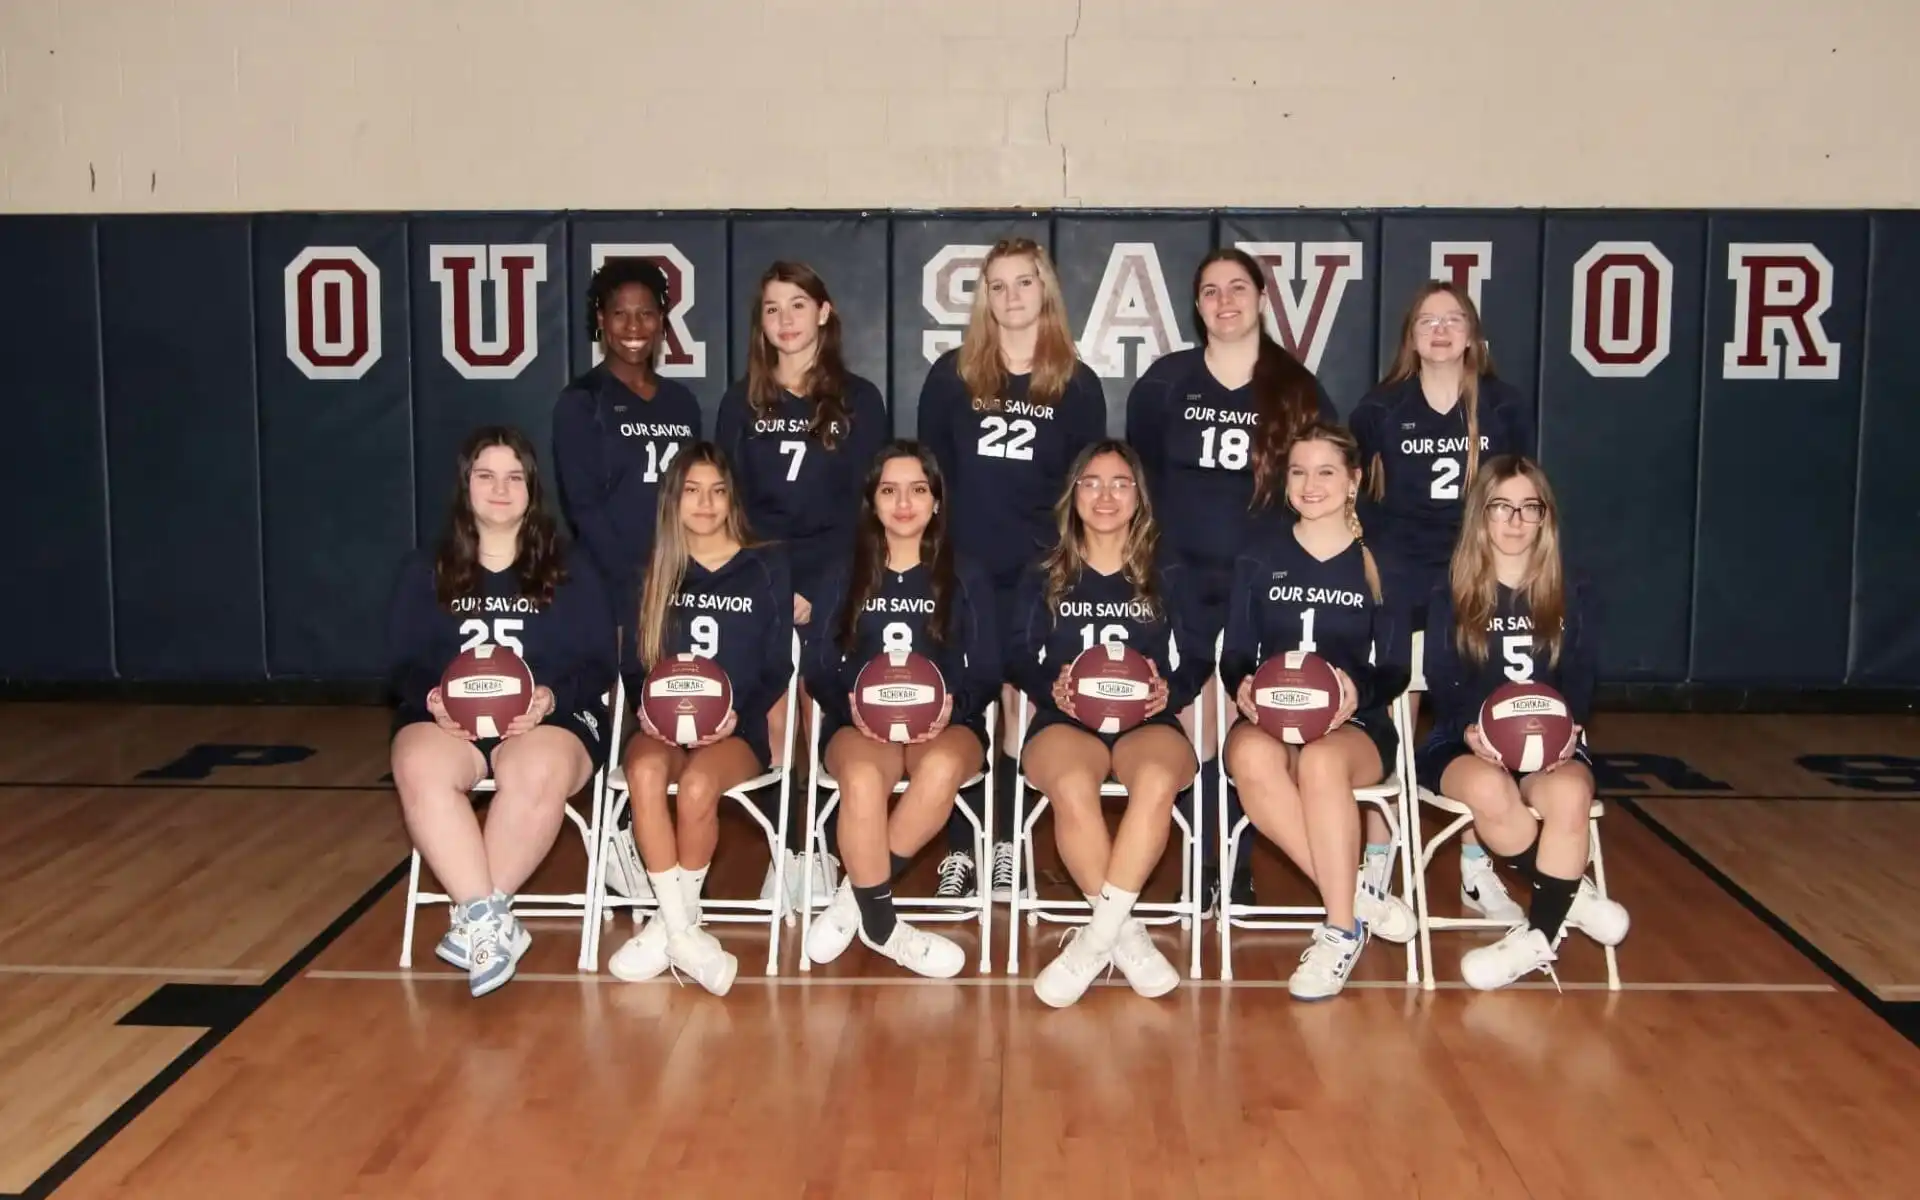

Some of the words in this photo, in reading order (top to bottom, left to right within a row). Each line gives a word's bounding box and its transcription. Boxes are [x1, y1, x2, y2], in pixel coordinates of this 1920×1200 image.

[1004, 399, 1054, 420] SAVIOR
[1184, 406, 1216, 421] OUR
[1218, 410, 1259, 426] SAVIO
[620, 422, 650, 437] OUR
[650, 423, 693, 438] SAVIOR
[755, 419, 786, 433] OUR
[788, 419, 839, 434] SAR
[977, 415, 1037, 461] 22
[1198, 426, 1250, 470] 18
[1401, 438, 1434, 454] OUR
[1437, 436, 1489, 453] SAVIR
[779, 440, 807, 481] 7
[1430, 457, 1460, 500] 2
[697, 593, 753, 613] SAVIOR
[862, 597, 887, 612] UR
[890, 598, 936, 613] SAVIO
[1269, 586, 1304, 602] OUR
[1306, 587, 1364, 608] SAVIOR
[1060, 602, 1093, 617] OUR
[1096, 602, 1154, 618] SAVIOR
[459, 618, 524, 659] 25
[690, 615, 719, 660] 9
[1299, 607, 1317, 653] 1
[1502, 635, 1534, 684] 5
